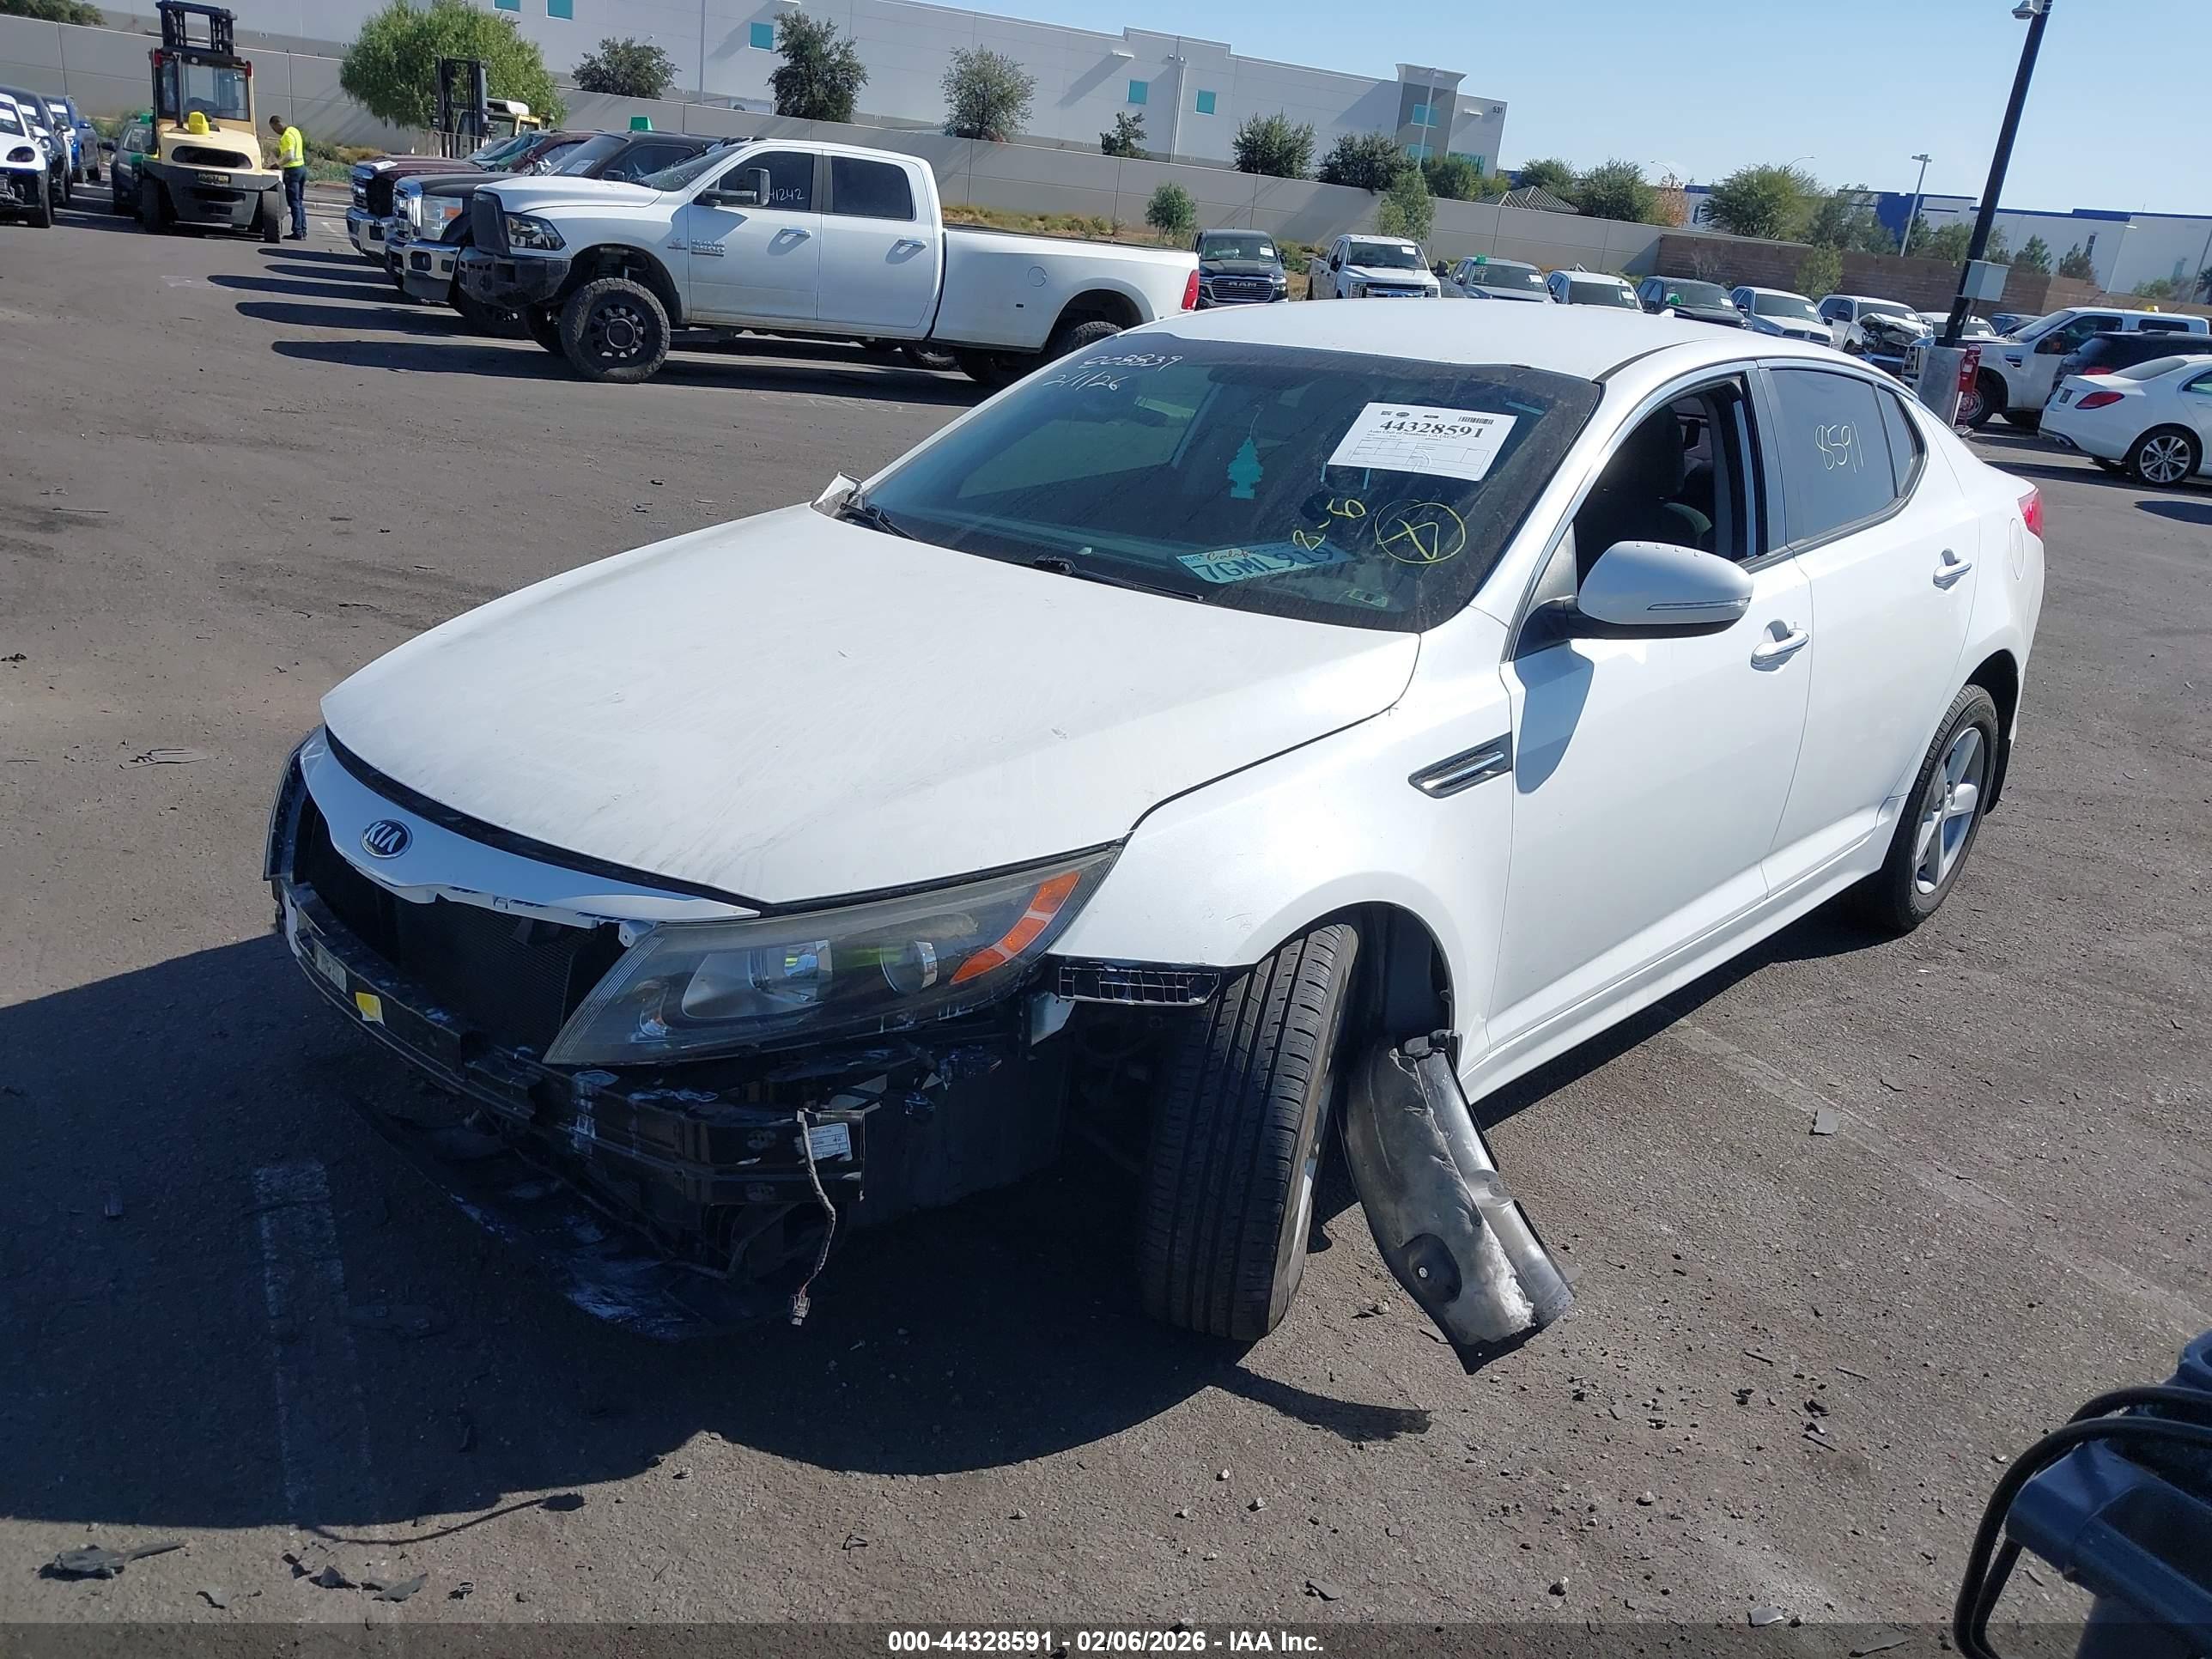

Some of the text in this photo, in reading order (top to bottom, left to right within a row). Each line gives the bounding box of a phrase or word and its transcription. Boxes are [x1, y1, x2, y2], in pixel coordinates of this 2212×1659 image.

[1380, 420, 1484, 438] 44328591
[1814, 420, 1864, 474] 8591
[1191, 546, 1334, 580] 7GML919
[364, 822, 402, 853] KIA
